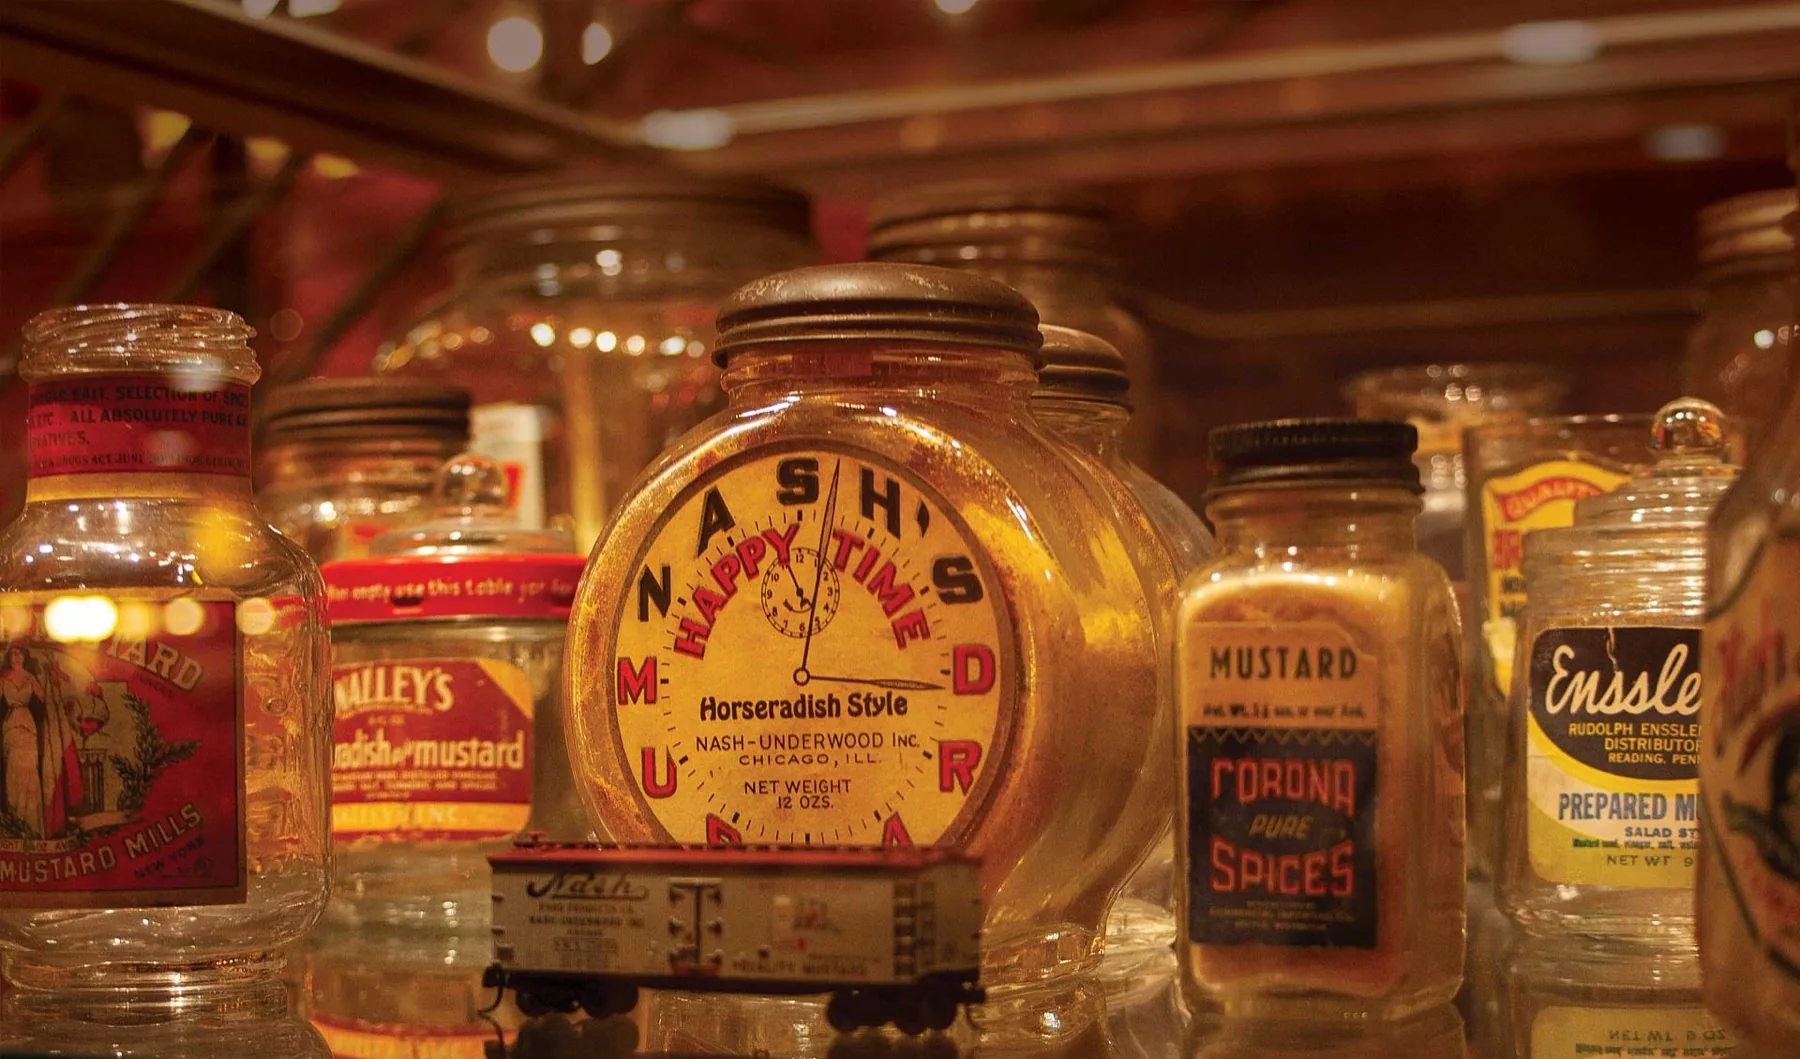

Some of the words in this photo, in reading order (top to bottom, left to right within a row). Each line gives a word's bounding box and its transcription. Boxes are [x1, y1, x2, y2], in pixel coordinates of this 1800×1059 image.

[116, 385, 197, 402] SELECTION
[71, 409, 97, 424] ALL
[100, 407, 197, 424] ABSOLUTELY
[202, 410, 234, 426] PURE
[674, 523, 800, 660] HAPPY
[832, 527, 931, 651] TIME
[1209, 644, 1358, 681] MUSTARD
[700, 693, 842, 721] Horseradish
[847, 690, 909, 719] Style
[1568, 722, 1634, 737] RUDOLPH
[414, 729, 525, 770] mustard
[696, 732, 884, 751] NASH-UNDERWOOD
[738, 753, 839, 768] CHICAGO,
[846, 752, 883, 764] ILL.
[745, 780, 780, 794] NET
[786, 778, 852, 794] WEIGHT
[1210, 757, 1358, 820] CORONA
[777, 796, 793, 809] 12
[799, 795, 835, 809] OZS.
[1558, 792, 1668, 821] PREPARED
[1249, 813, 1315, 840] PURE
[1624, 826, 1673, 838] SALAD
[0, 843, 117, 885] MUSTARD
[123, 803, 203, 860] MILLS
[1209, 832, 1356, 897] SPICES
[1607, 855, 1639, 866] NET
[1645, 855, 1671, 867] WT
[1683, 856, 1694, 868] 9
